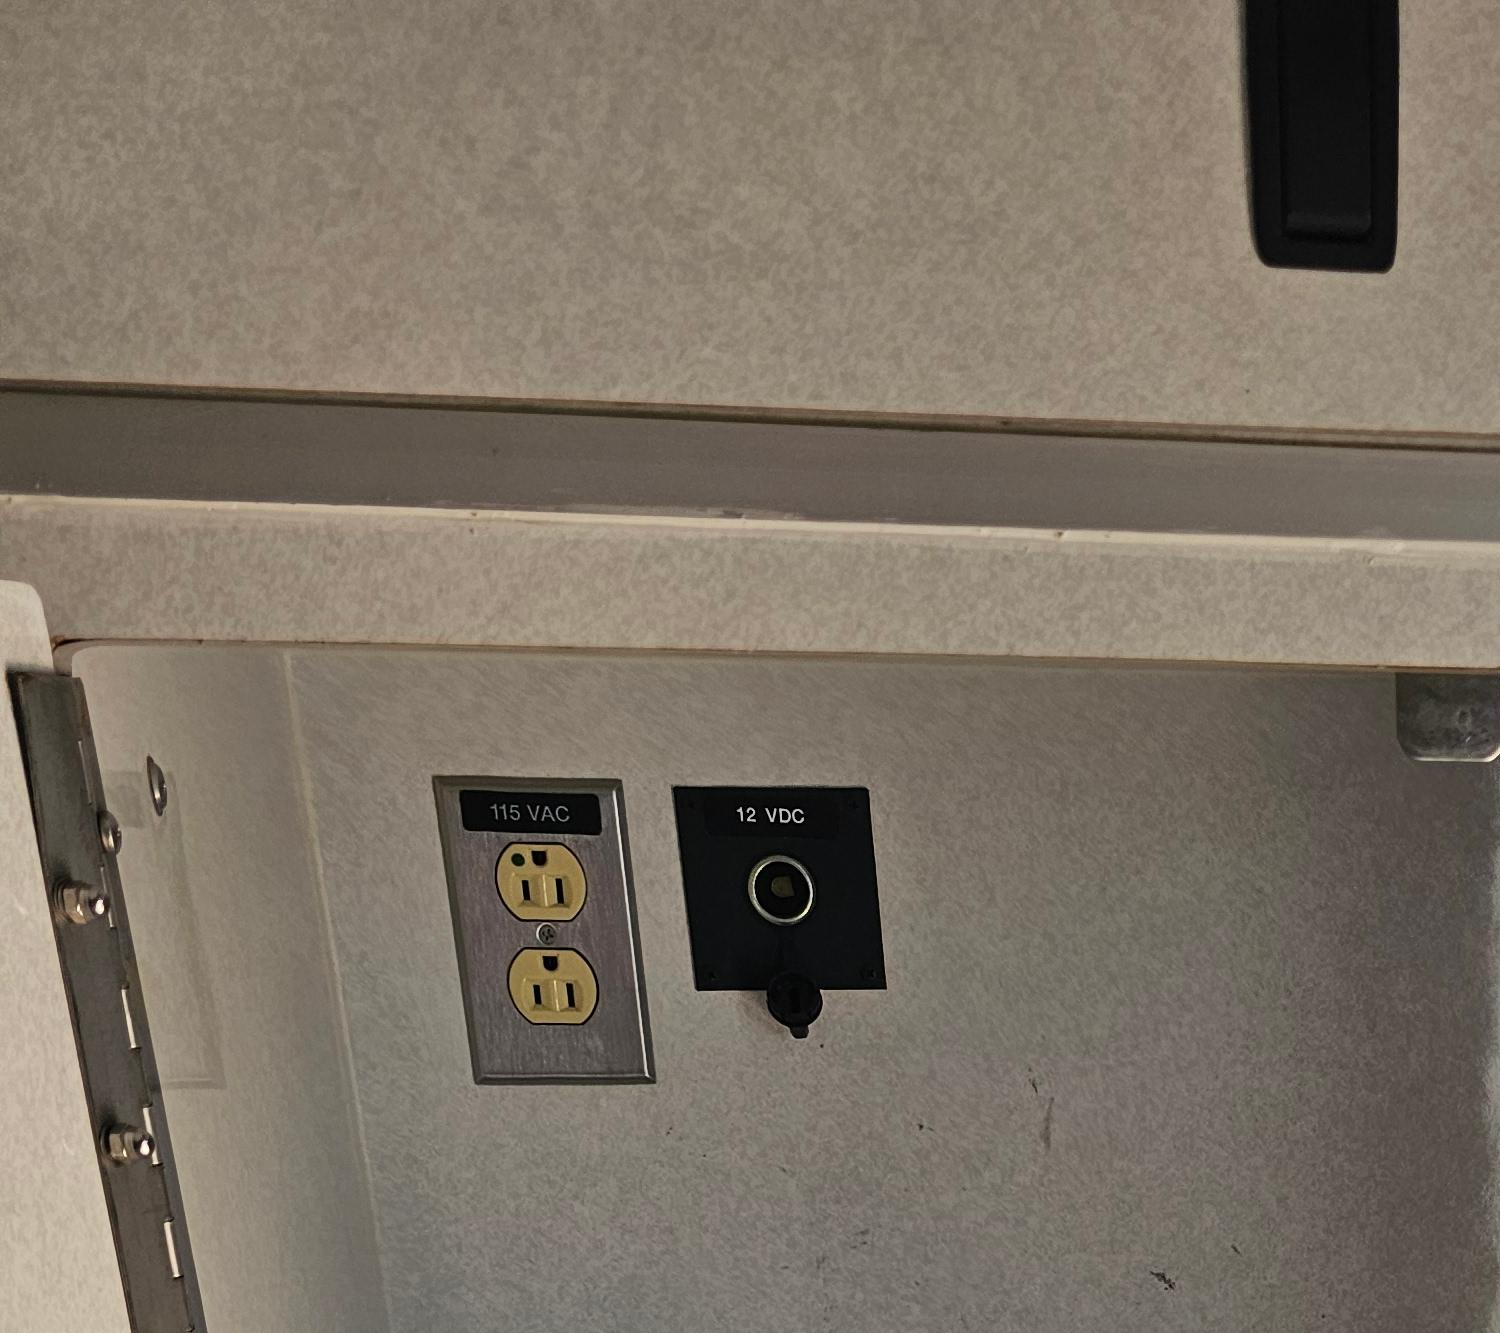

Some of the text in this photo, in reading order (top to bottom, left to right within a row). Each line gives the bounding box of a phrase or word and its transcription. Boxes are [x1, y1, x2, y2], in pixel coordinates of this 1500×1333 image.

[489, 803, 571, 823] 115 VAC
[736, 806, 806, 824] 12 VDC
